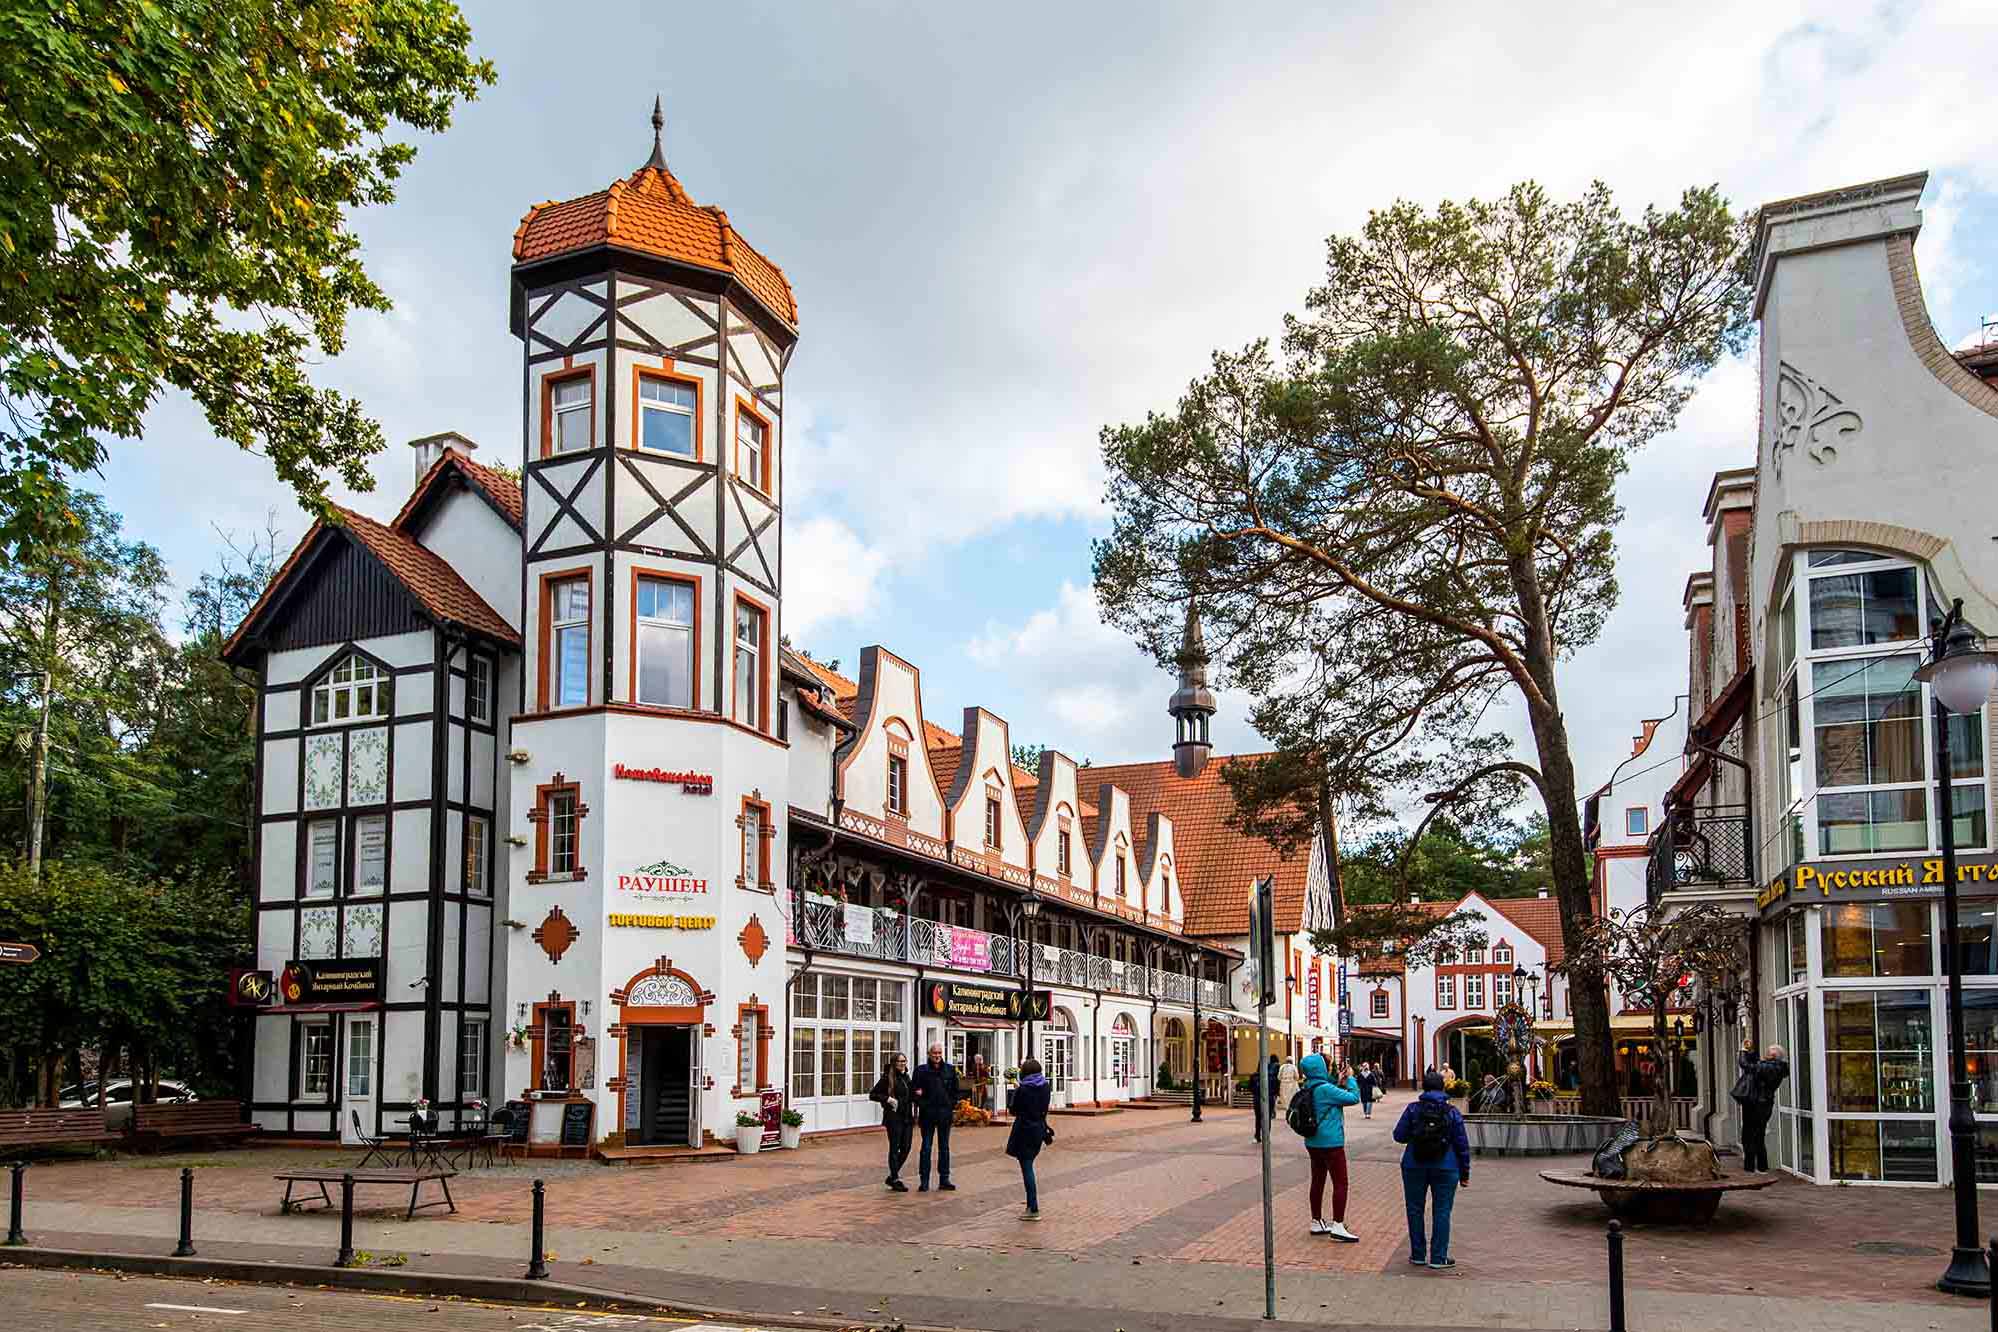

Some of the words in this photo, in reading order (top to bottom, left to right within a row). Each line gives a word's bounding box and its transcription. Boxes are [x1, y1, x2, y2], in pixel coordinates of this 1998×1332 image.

[617, 875, 708, 894] РАУШЕН
[1794, 862, 1915, 897] Русский
[1881, 887, 1919, 896] RUSSIAN
[952, 983, 1005, 1001] Калининградский
